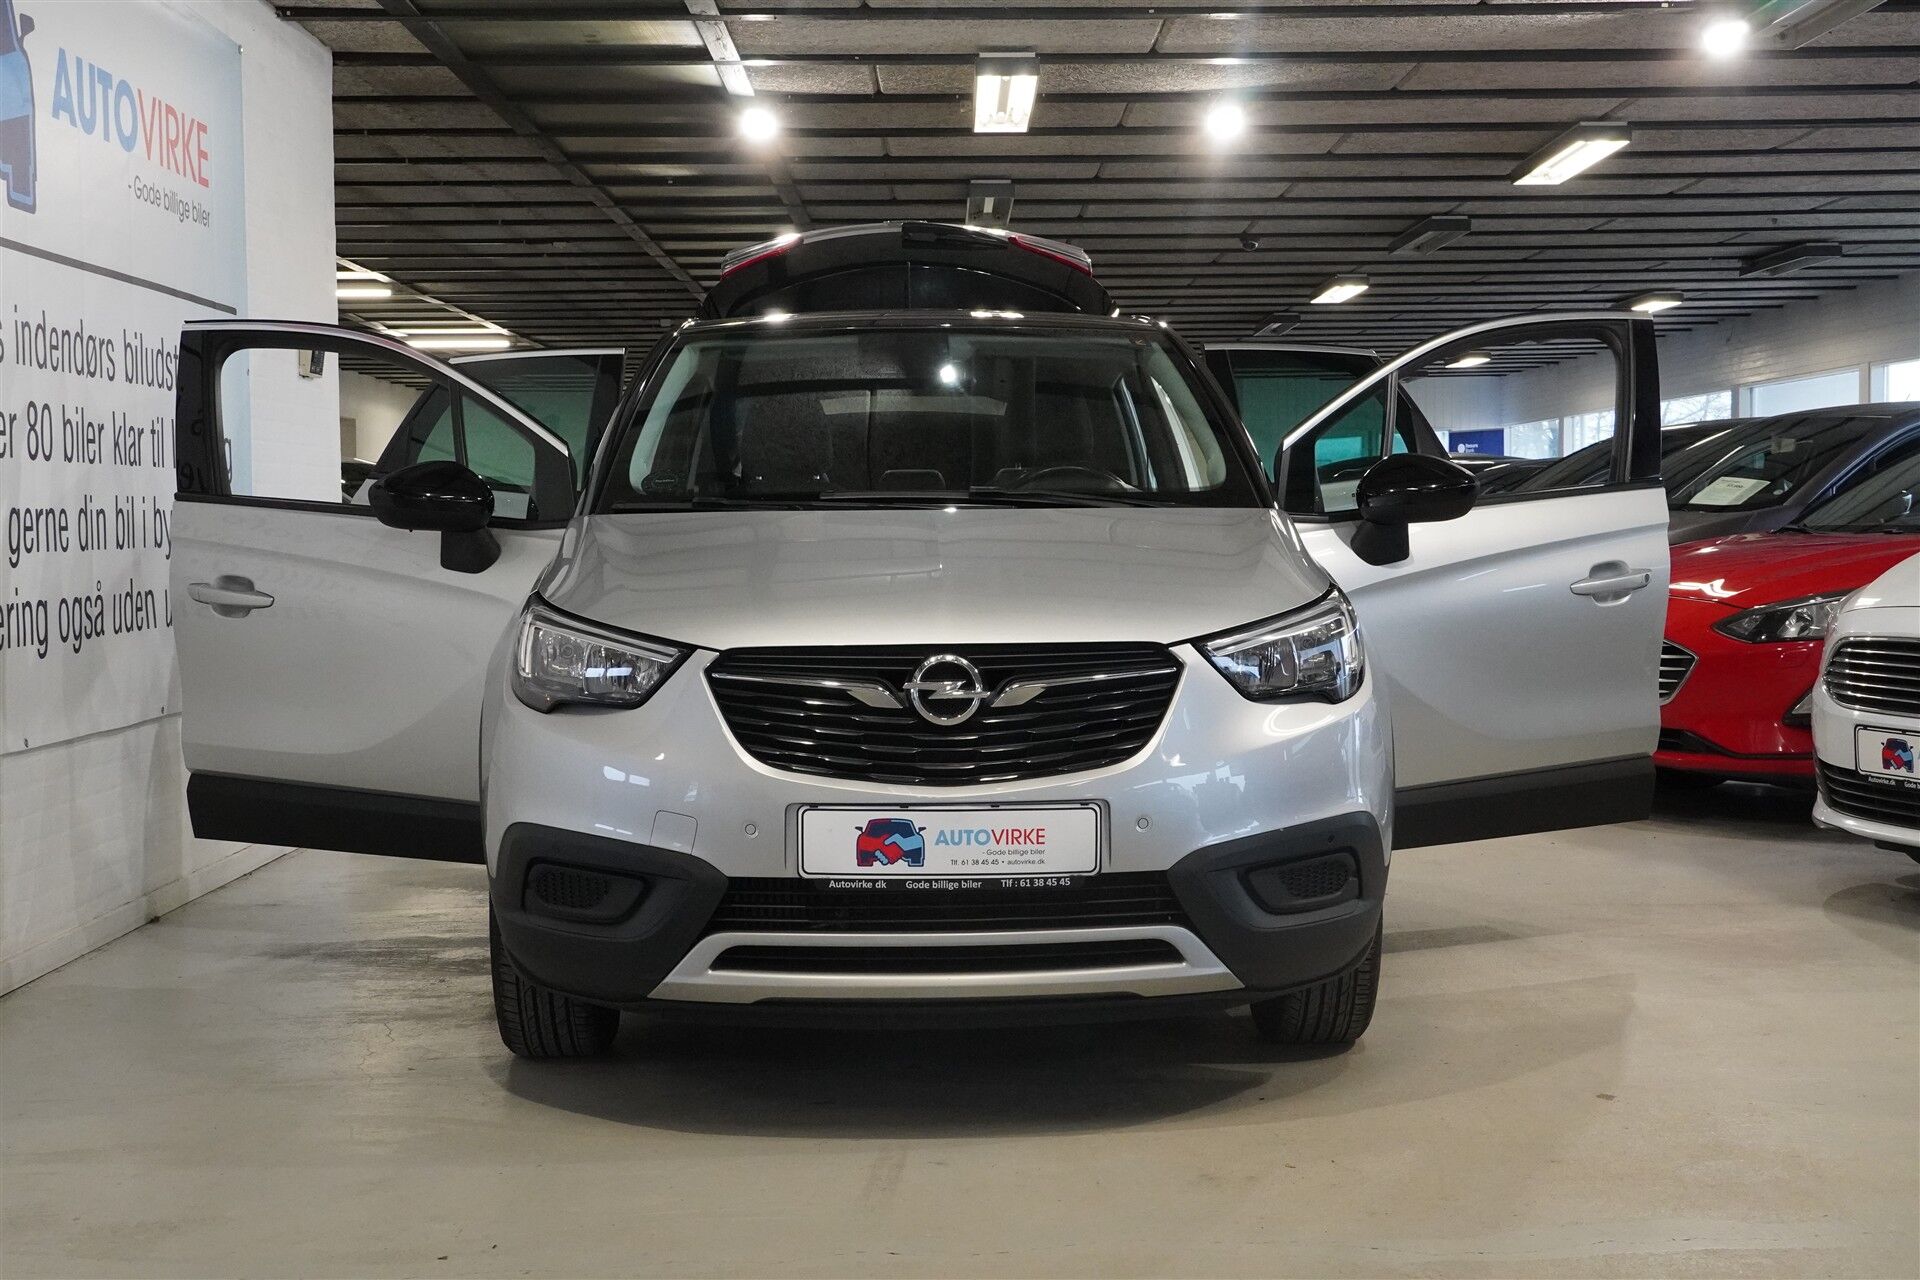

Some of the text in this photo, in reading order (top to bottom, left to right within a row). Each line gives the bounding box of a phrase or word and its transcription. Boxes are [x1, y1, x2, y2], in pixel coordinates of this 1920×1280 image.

[51, 47, 209, 188] AUTOVIRKE
[133, 175, 161, 207] Gode
[163, 187, 190, 223] billige
[192, 200, 210, 228] biler
[14, 304, 116, 382] indendørs
[27, 400, 53, 461] 80
[62, 404, 104, 465] biler
[112, 411, 144, 467] klar
[150, 416, 165, 468] til
[8, 507, 69, 569] gerne
[77, 494, 107, 552] din
[115, 495, 135, 550] bil
[142, 496, 146, 548] i
[58, 580, 105, 654] også
[113, 578, 157, 635] uden
[934, 828, 1046, 846] AUTOVIRKE
[1007, 848, 1029, 857] billige
[1030, 848, 1046, 856] biler
[828, 880, 873, 889] Autovirke
[905, 880, 930, 889] Gode
[932, 880, 959, 891] billige
[961, 879, 983, 889] biler
[1020, 878, 1031, 887] 61
[1033, 878, 1045, 887] 38
[1046, 878, 1057, 886] 45
[1059, 877, 1071, 886] 45
